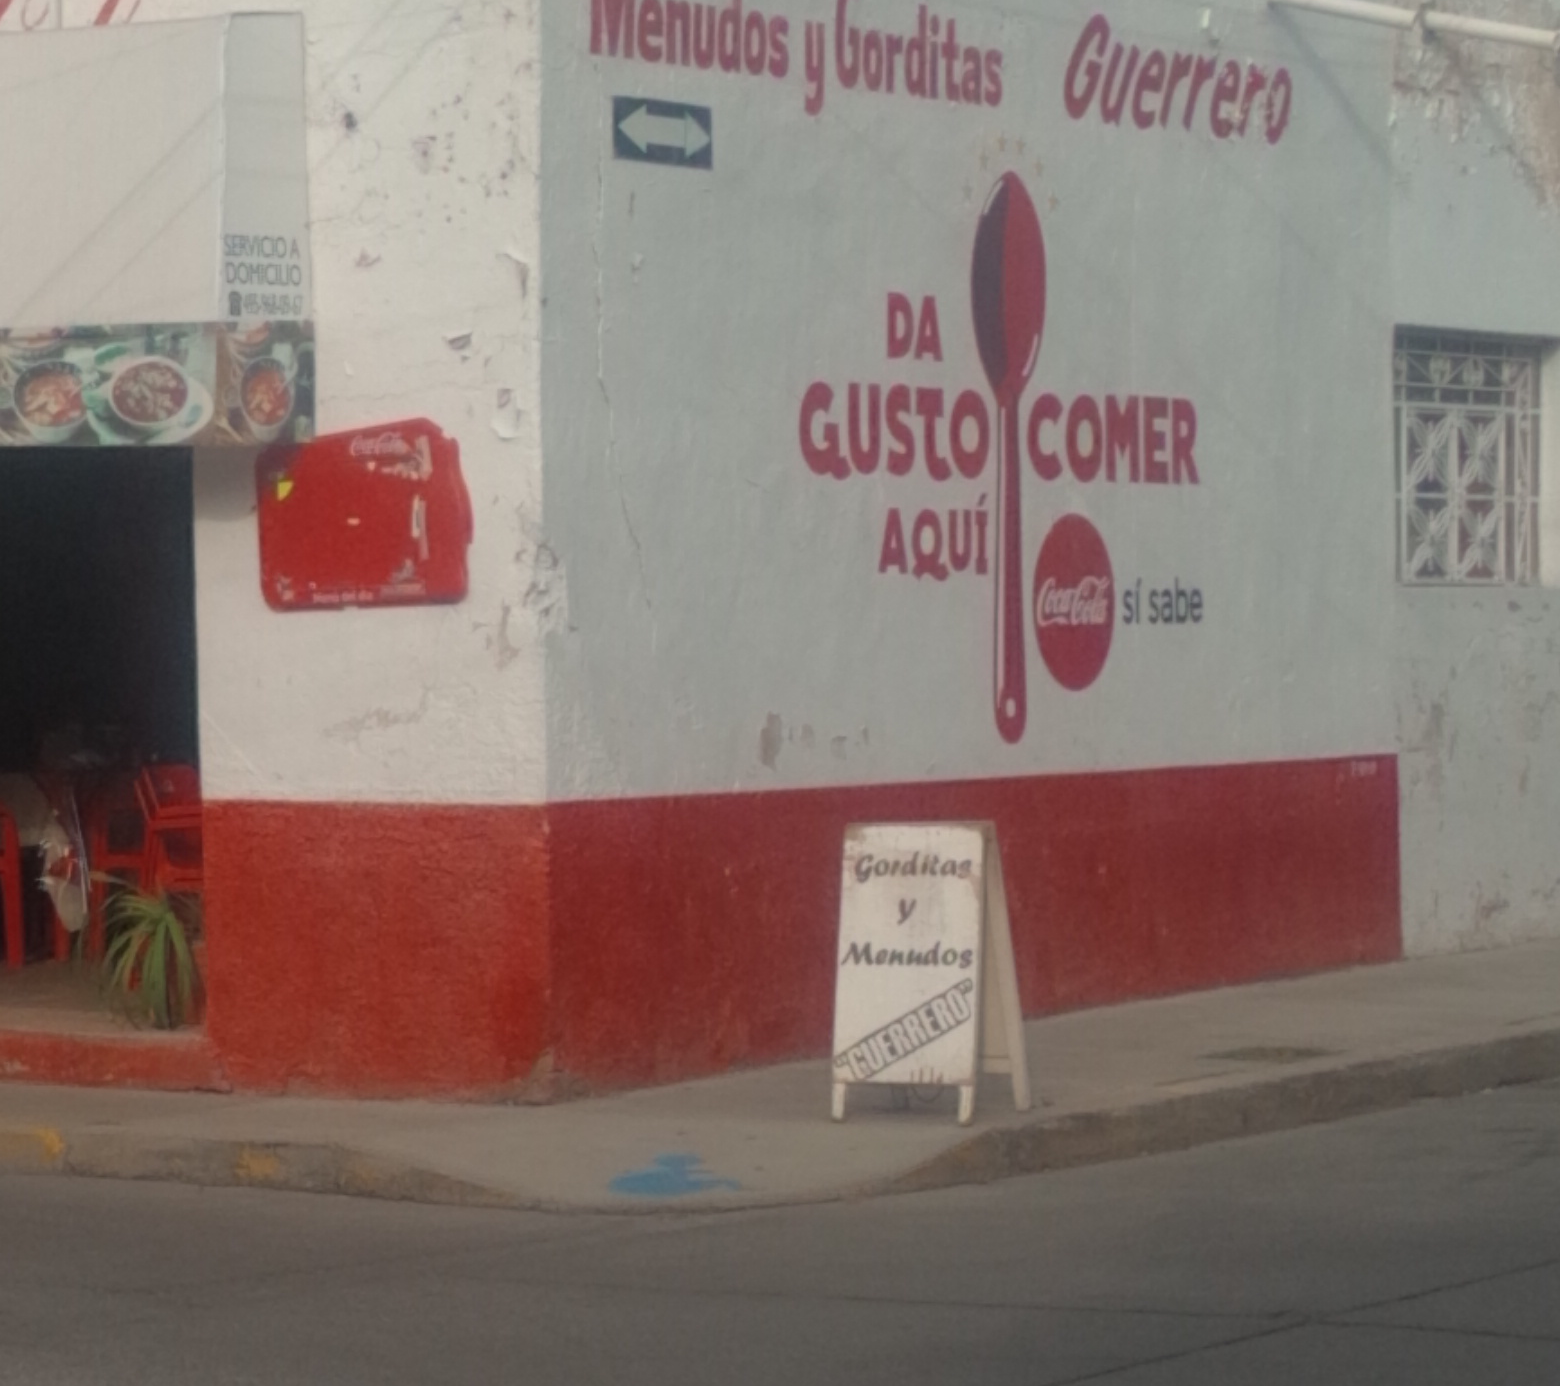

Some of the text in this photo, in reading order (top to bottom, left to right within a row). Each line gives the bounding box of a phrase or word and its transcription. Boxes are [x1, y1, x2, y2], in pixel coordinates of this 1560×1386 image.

[803, 23, 826, 117] y
[1062, 12, 1294, 145] Guerrero
[224, 233, 301, 260] SERVICIO A
[224, 261, 302, 287] DOMICILIO
[886, 292, 943, 363] DA
[797, 380, 1201, 486] GUSTO COMER
[877, 494, 990, 582] AQUÍ
[1037, 575, 1203, 627] Coca-Cola sí sabe
[855, 850, 972, 883] Gorditas
[897, 898, 917, 925] y
[841, 941, 974, 969] Menudos
